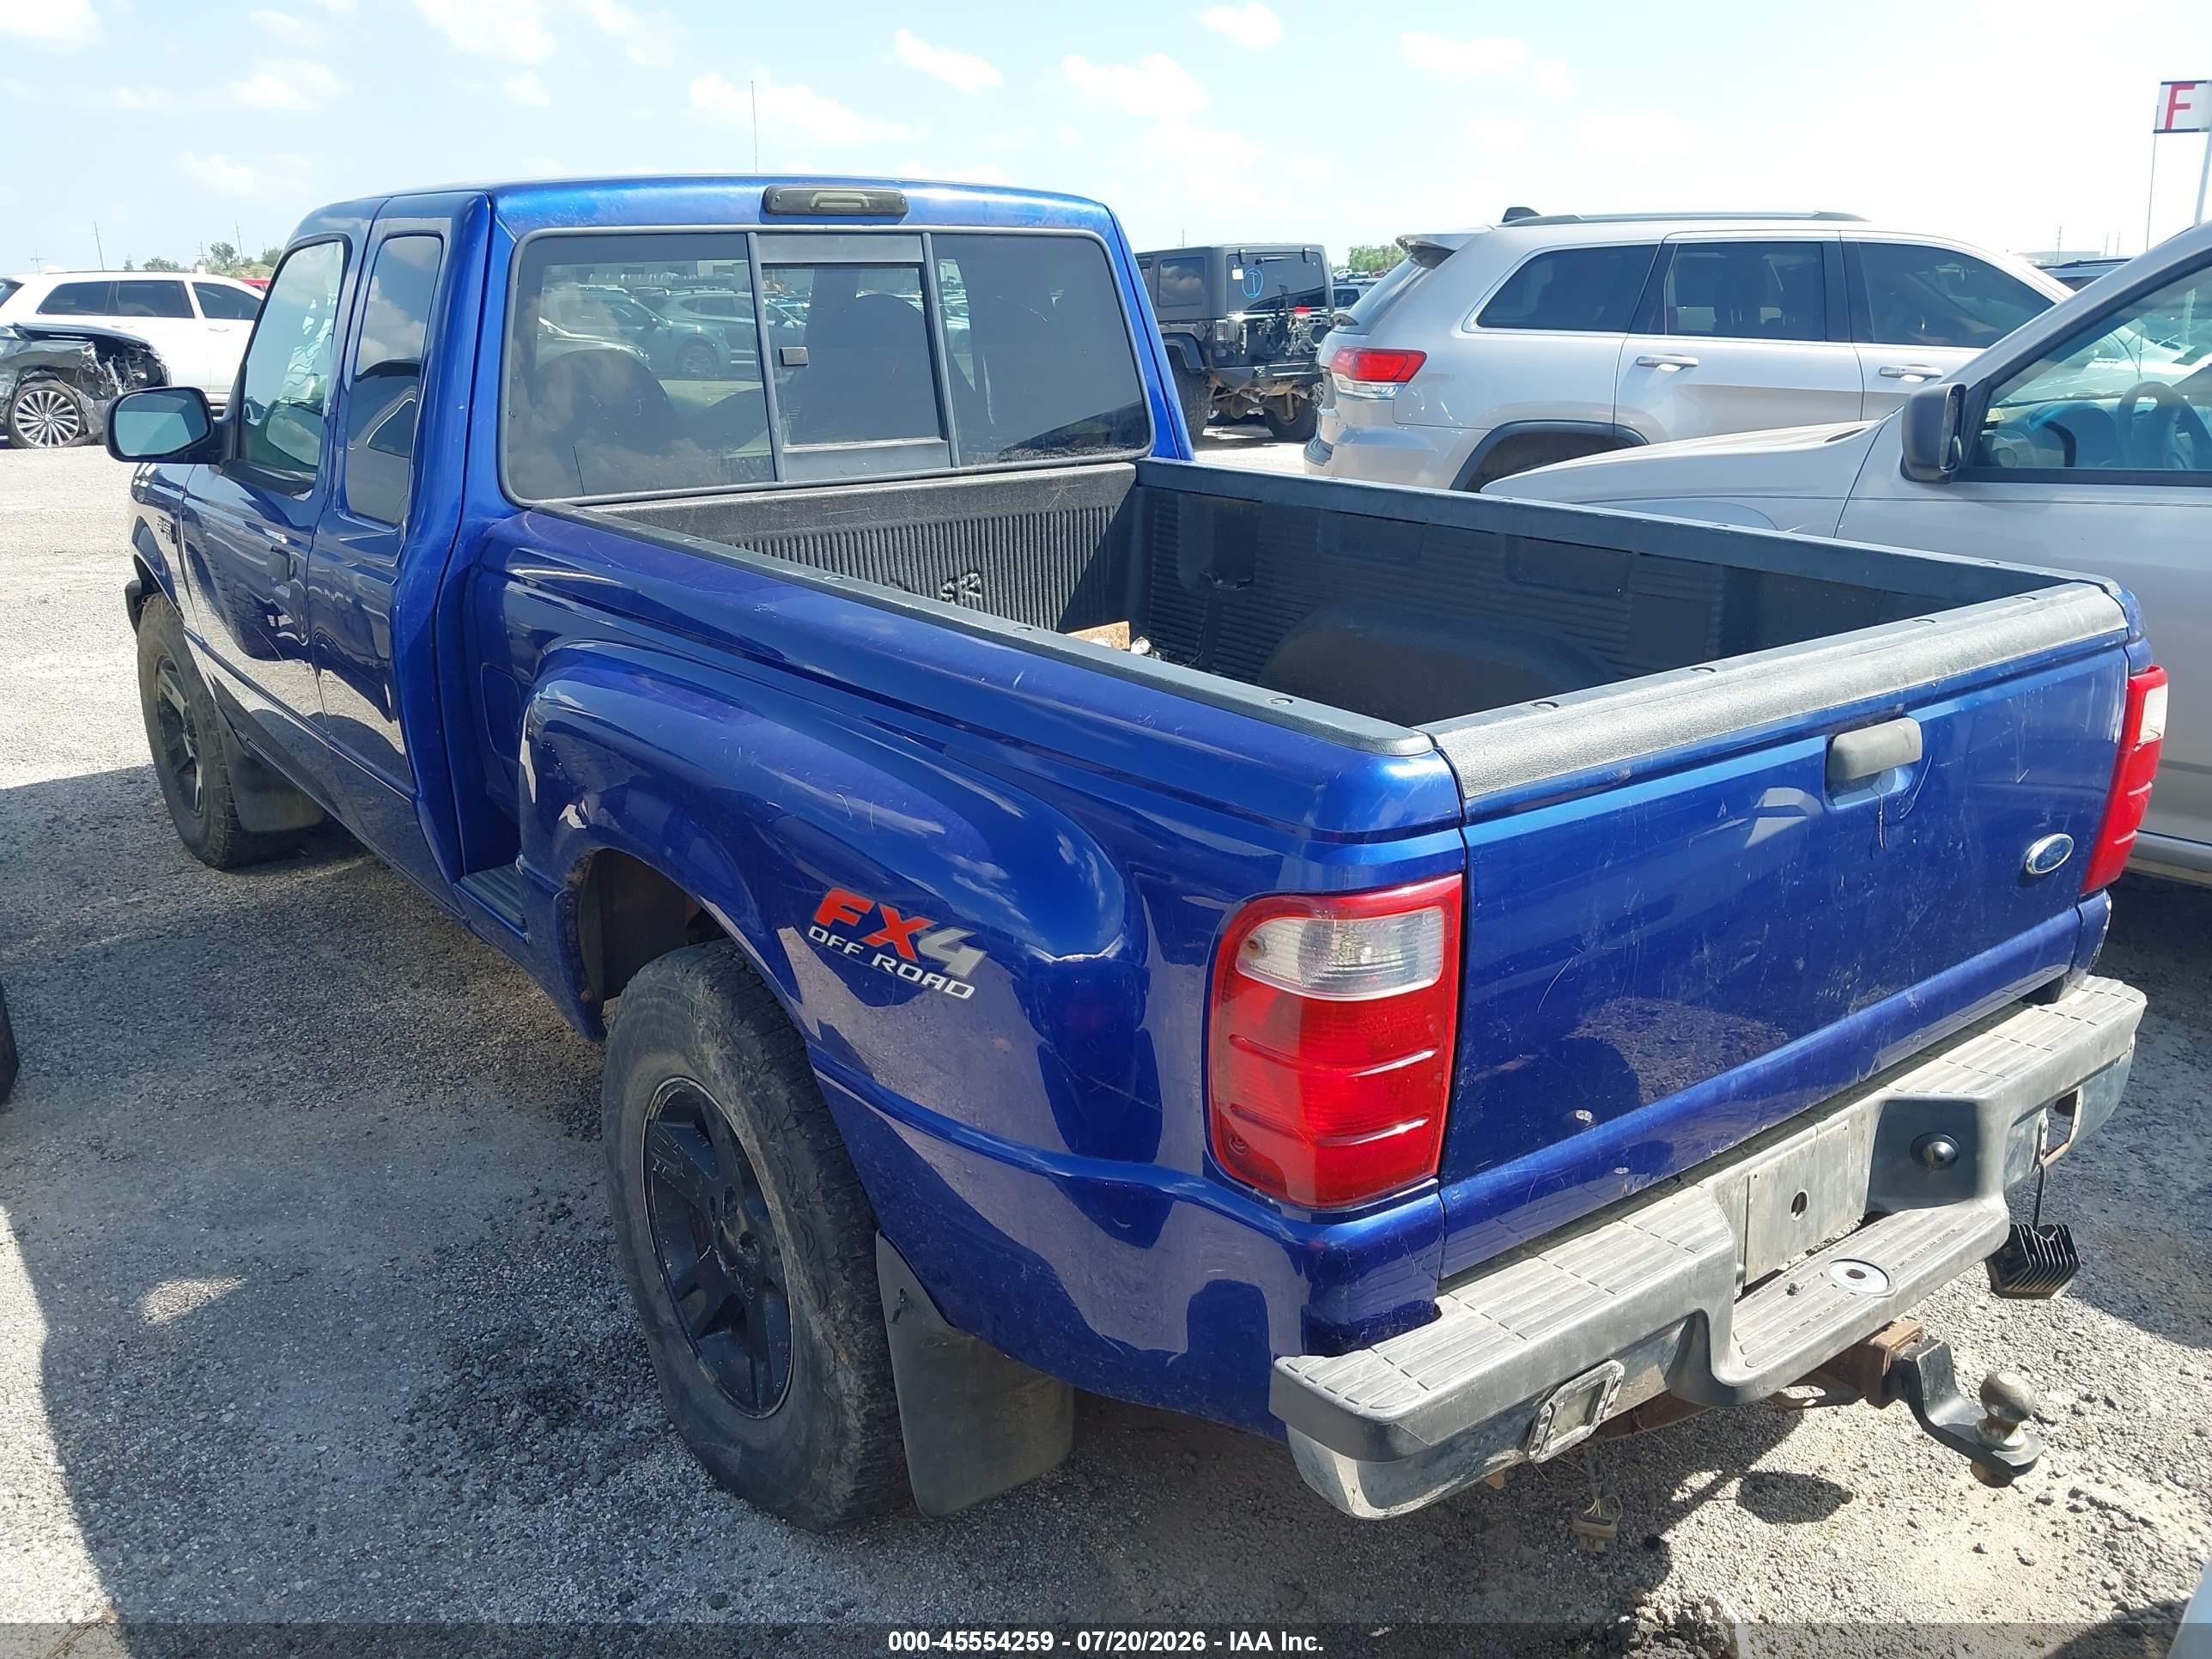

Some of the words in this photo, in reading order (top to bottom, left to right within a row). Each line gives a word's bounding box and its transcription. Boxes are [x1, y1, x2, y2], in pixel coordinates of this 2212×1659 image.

[2164, 82, 2195, 131] F
[808, 925, 865, 956] OFF
[871, 952, 975, 1000] ROAD
[813, 886, 988, 979] FX4
